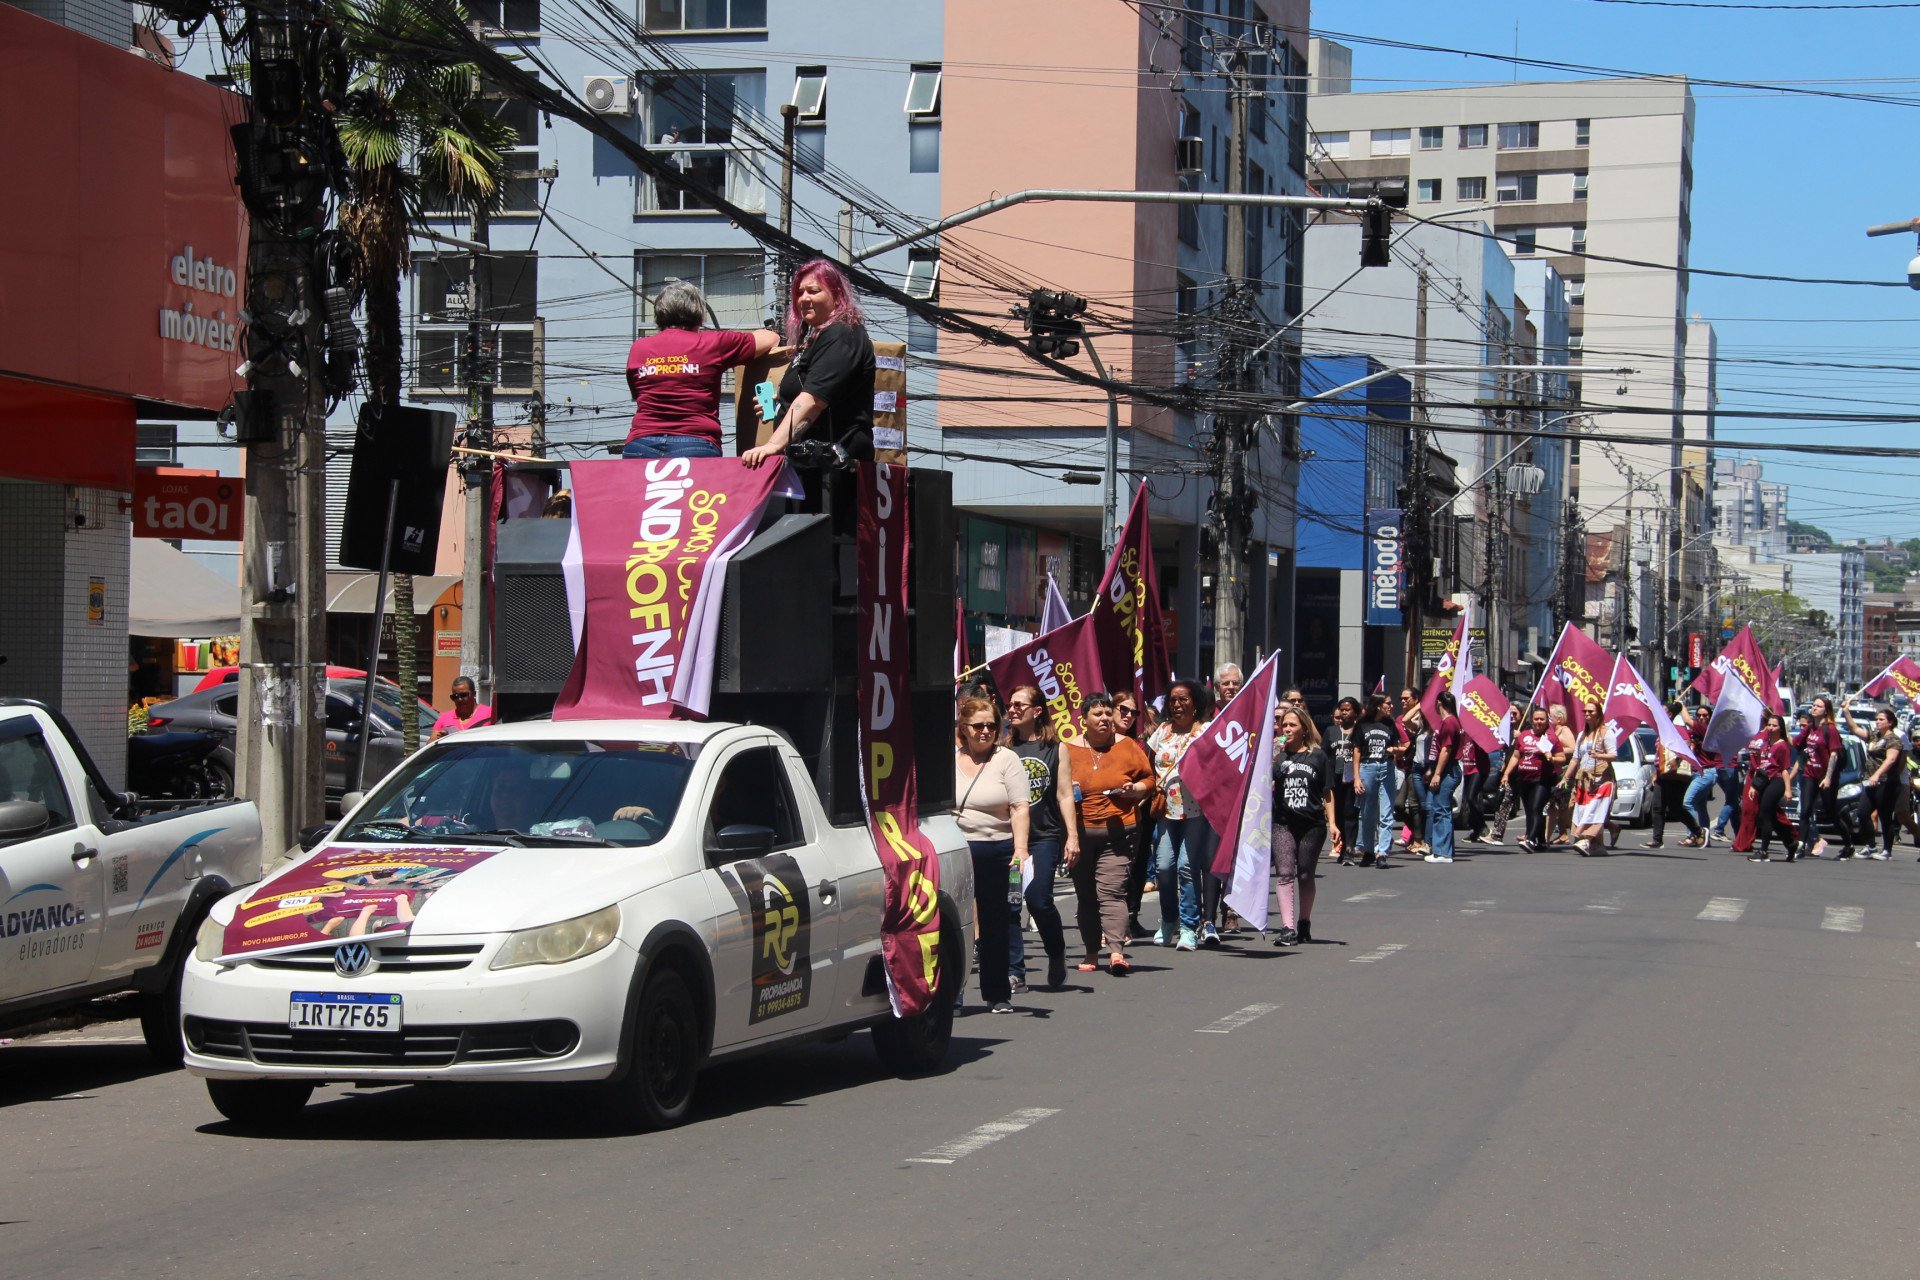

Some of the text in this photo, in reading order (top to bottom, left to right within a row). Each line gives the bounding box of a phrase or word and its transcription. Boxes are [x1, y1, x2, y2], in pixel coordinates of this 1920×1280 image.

[171, 246, 236, 297] eletro
[160, 302, 235, 352] móveis
[645, 355, 688, 367] SOMOS TODOS
[162, 485, 189, 494] LOJAS
[144, 483, 233, 535] taQi
[681, 489, 727, 555] SOMOS
[1562, 655, 1594, 684] SOMOS
[1055, 662, 1083, 710] SOMOS
[1288, 797, 1307, 808] AQUI
[284, 898, 308, 907] SIM
[137, 920, 166, 933] SERVIÇO
[19, 931, 86, 961] elevadores
[136, 934, 163, 948] 24 HORAS
[242, 937, 264, 947] NOVO
[759, 977, 803, 1002] PROPAGANDA
[298, 1003, 390, 1028] IRT7F65
[757, 1004, 766, 1018] 51
